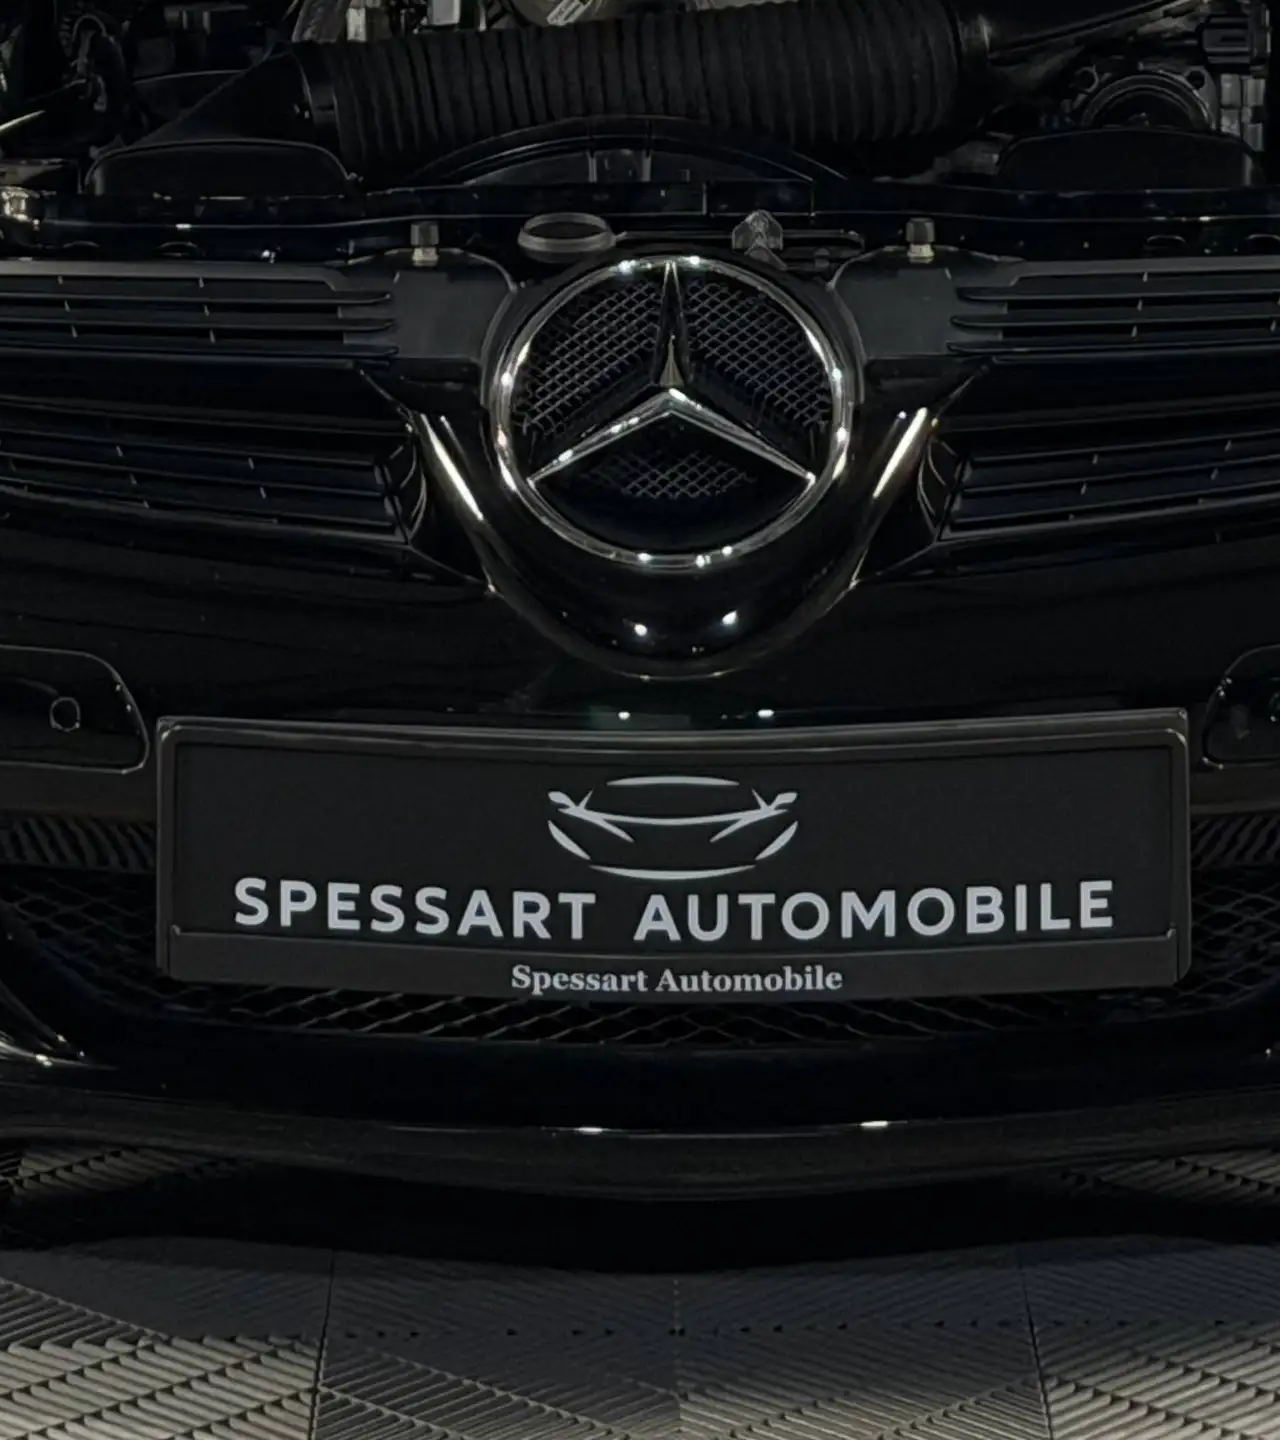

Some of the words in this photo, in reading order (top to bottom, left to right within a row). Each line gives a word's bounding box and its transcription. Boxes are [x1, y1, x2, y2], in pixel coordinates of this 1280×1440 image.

[234, 876, 597, 941] SPESSART
[632, 879, 1114, 943] AUTOMOBILE
[510, 964, 650, 997] Spessart
[654, 964, 844, 994] Automobile
